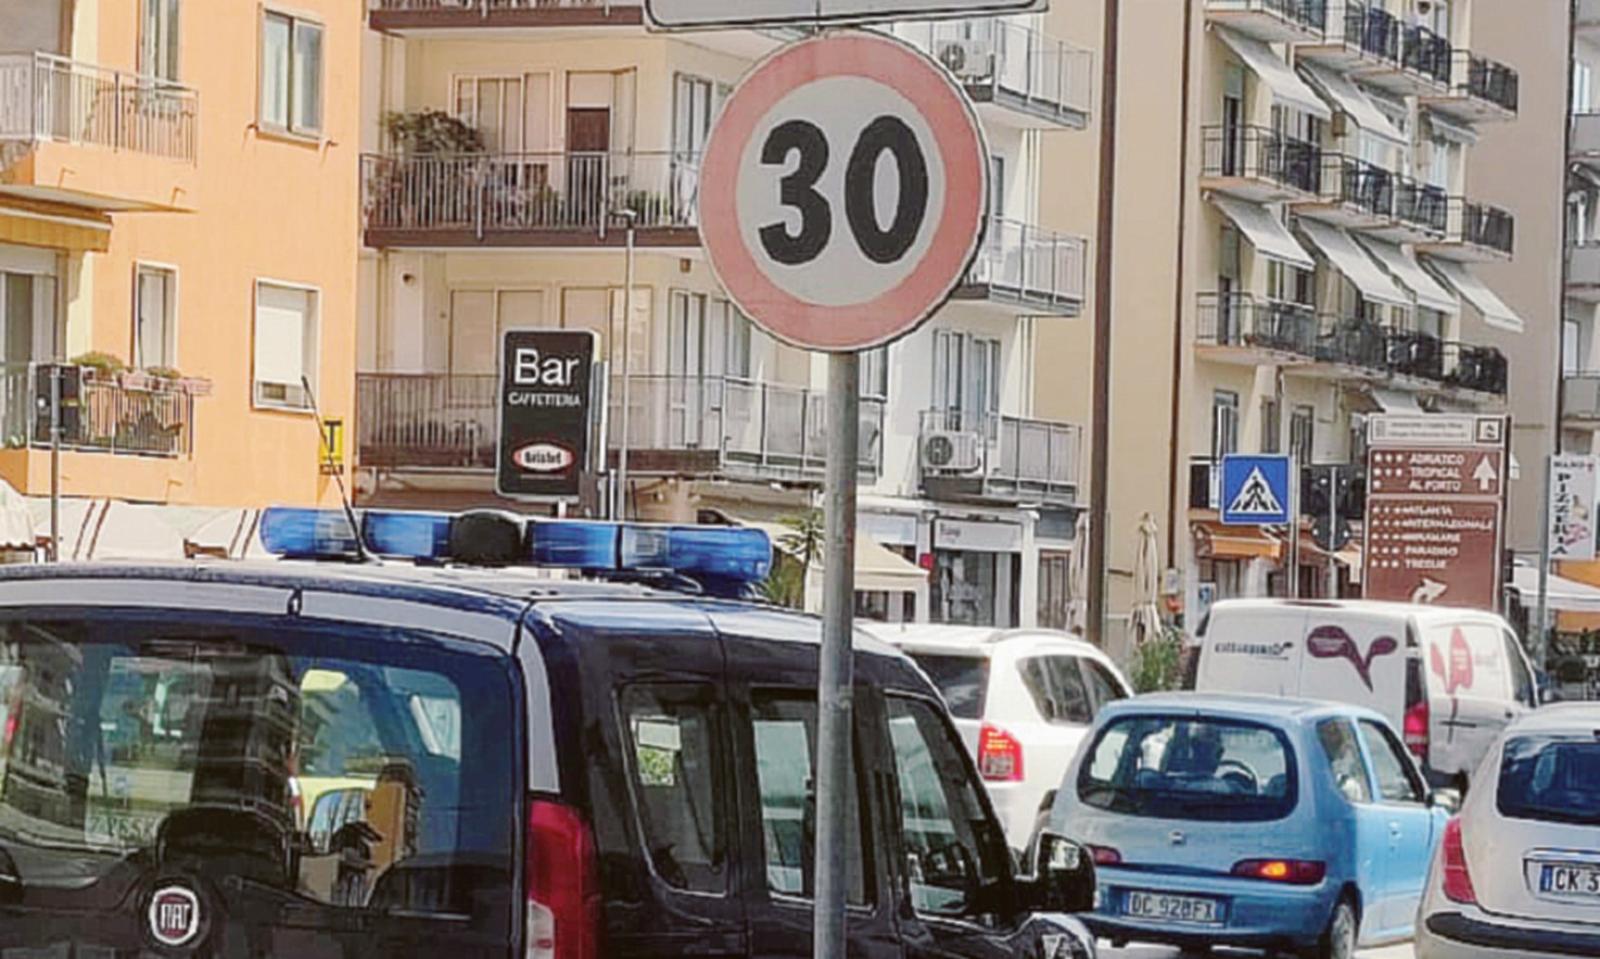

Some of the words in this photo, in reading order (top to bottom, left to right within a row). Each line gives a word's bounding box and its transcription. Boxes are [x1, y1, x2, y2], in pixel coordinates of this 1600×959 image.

[758, 115, 928, 265] 30
[514, 348, 579, 386] Bar
[507, 391, 581, 407] CAFFETTERIA
[323, 421, 342, 452] T
[1408, 453, 1465, 466] ADRIATICO
[1409, 466, 1462, 479] TROPICAL
[1408, 480, 1424, 491] AL
[1424, 481, 1462, 493] PORTO
[1552, 472, 1571, 555] PIZZERIA
[1404, 545, 1459, 557] PARADISO
[1556, 868, 1580, 891] CK
